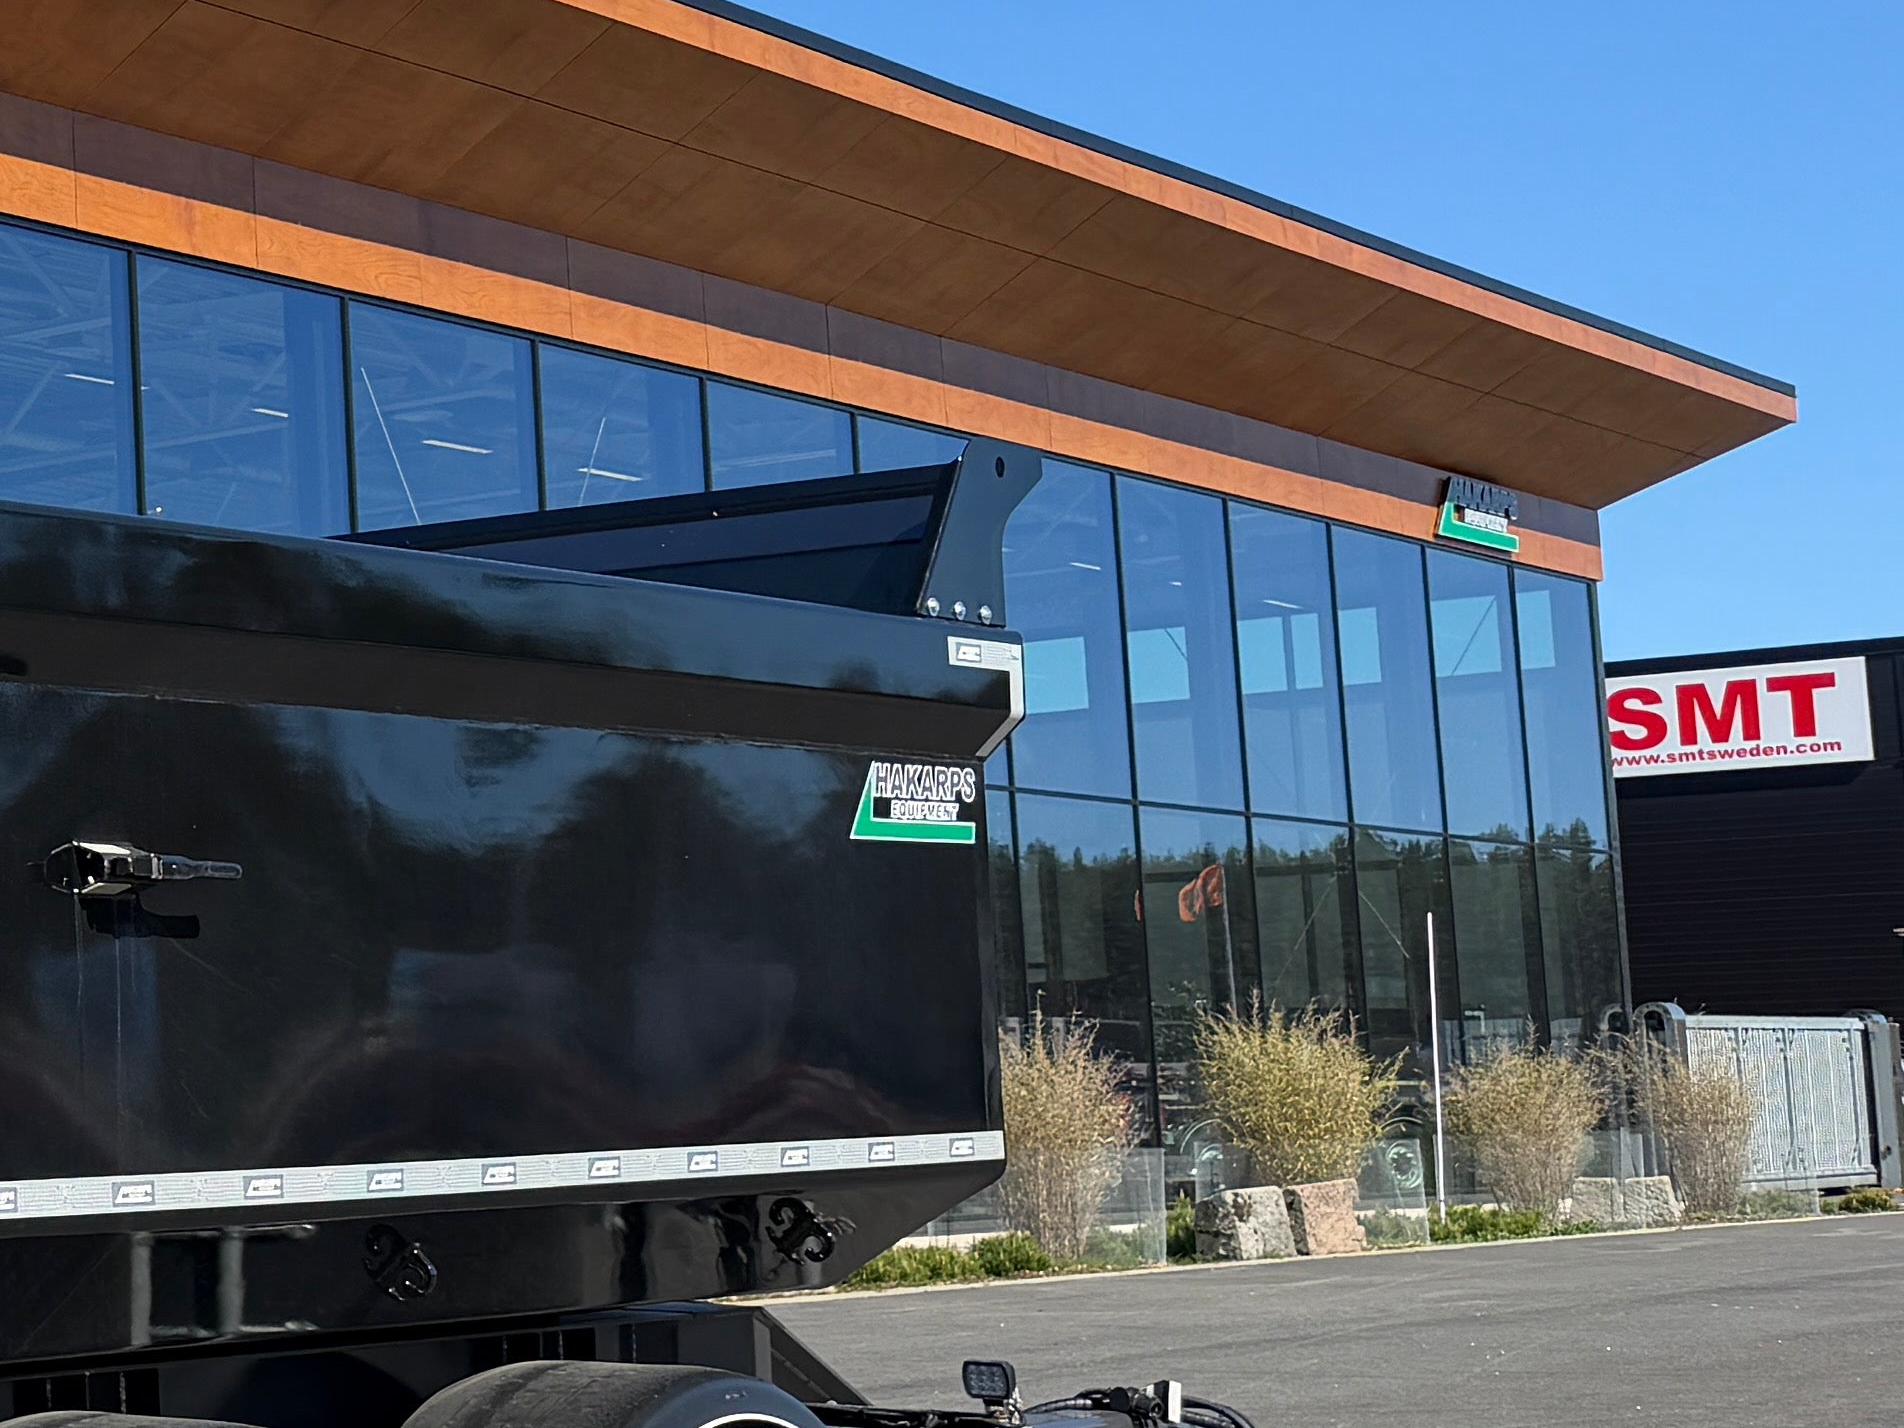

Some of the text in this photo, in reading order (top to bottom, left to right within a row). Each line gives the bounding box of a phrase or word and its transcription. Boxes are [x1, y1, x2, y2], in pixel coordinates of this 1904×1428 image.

[1607, 671, 1836, 751] SMT
[1611, 738, 1842, 767] www.smtsweden.com
[873, 762, 976, 803] HAKARPS
